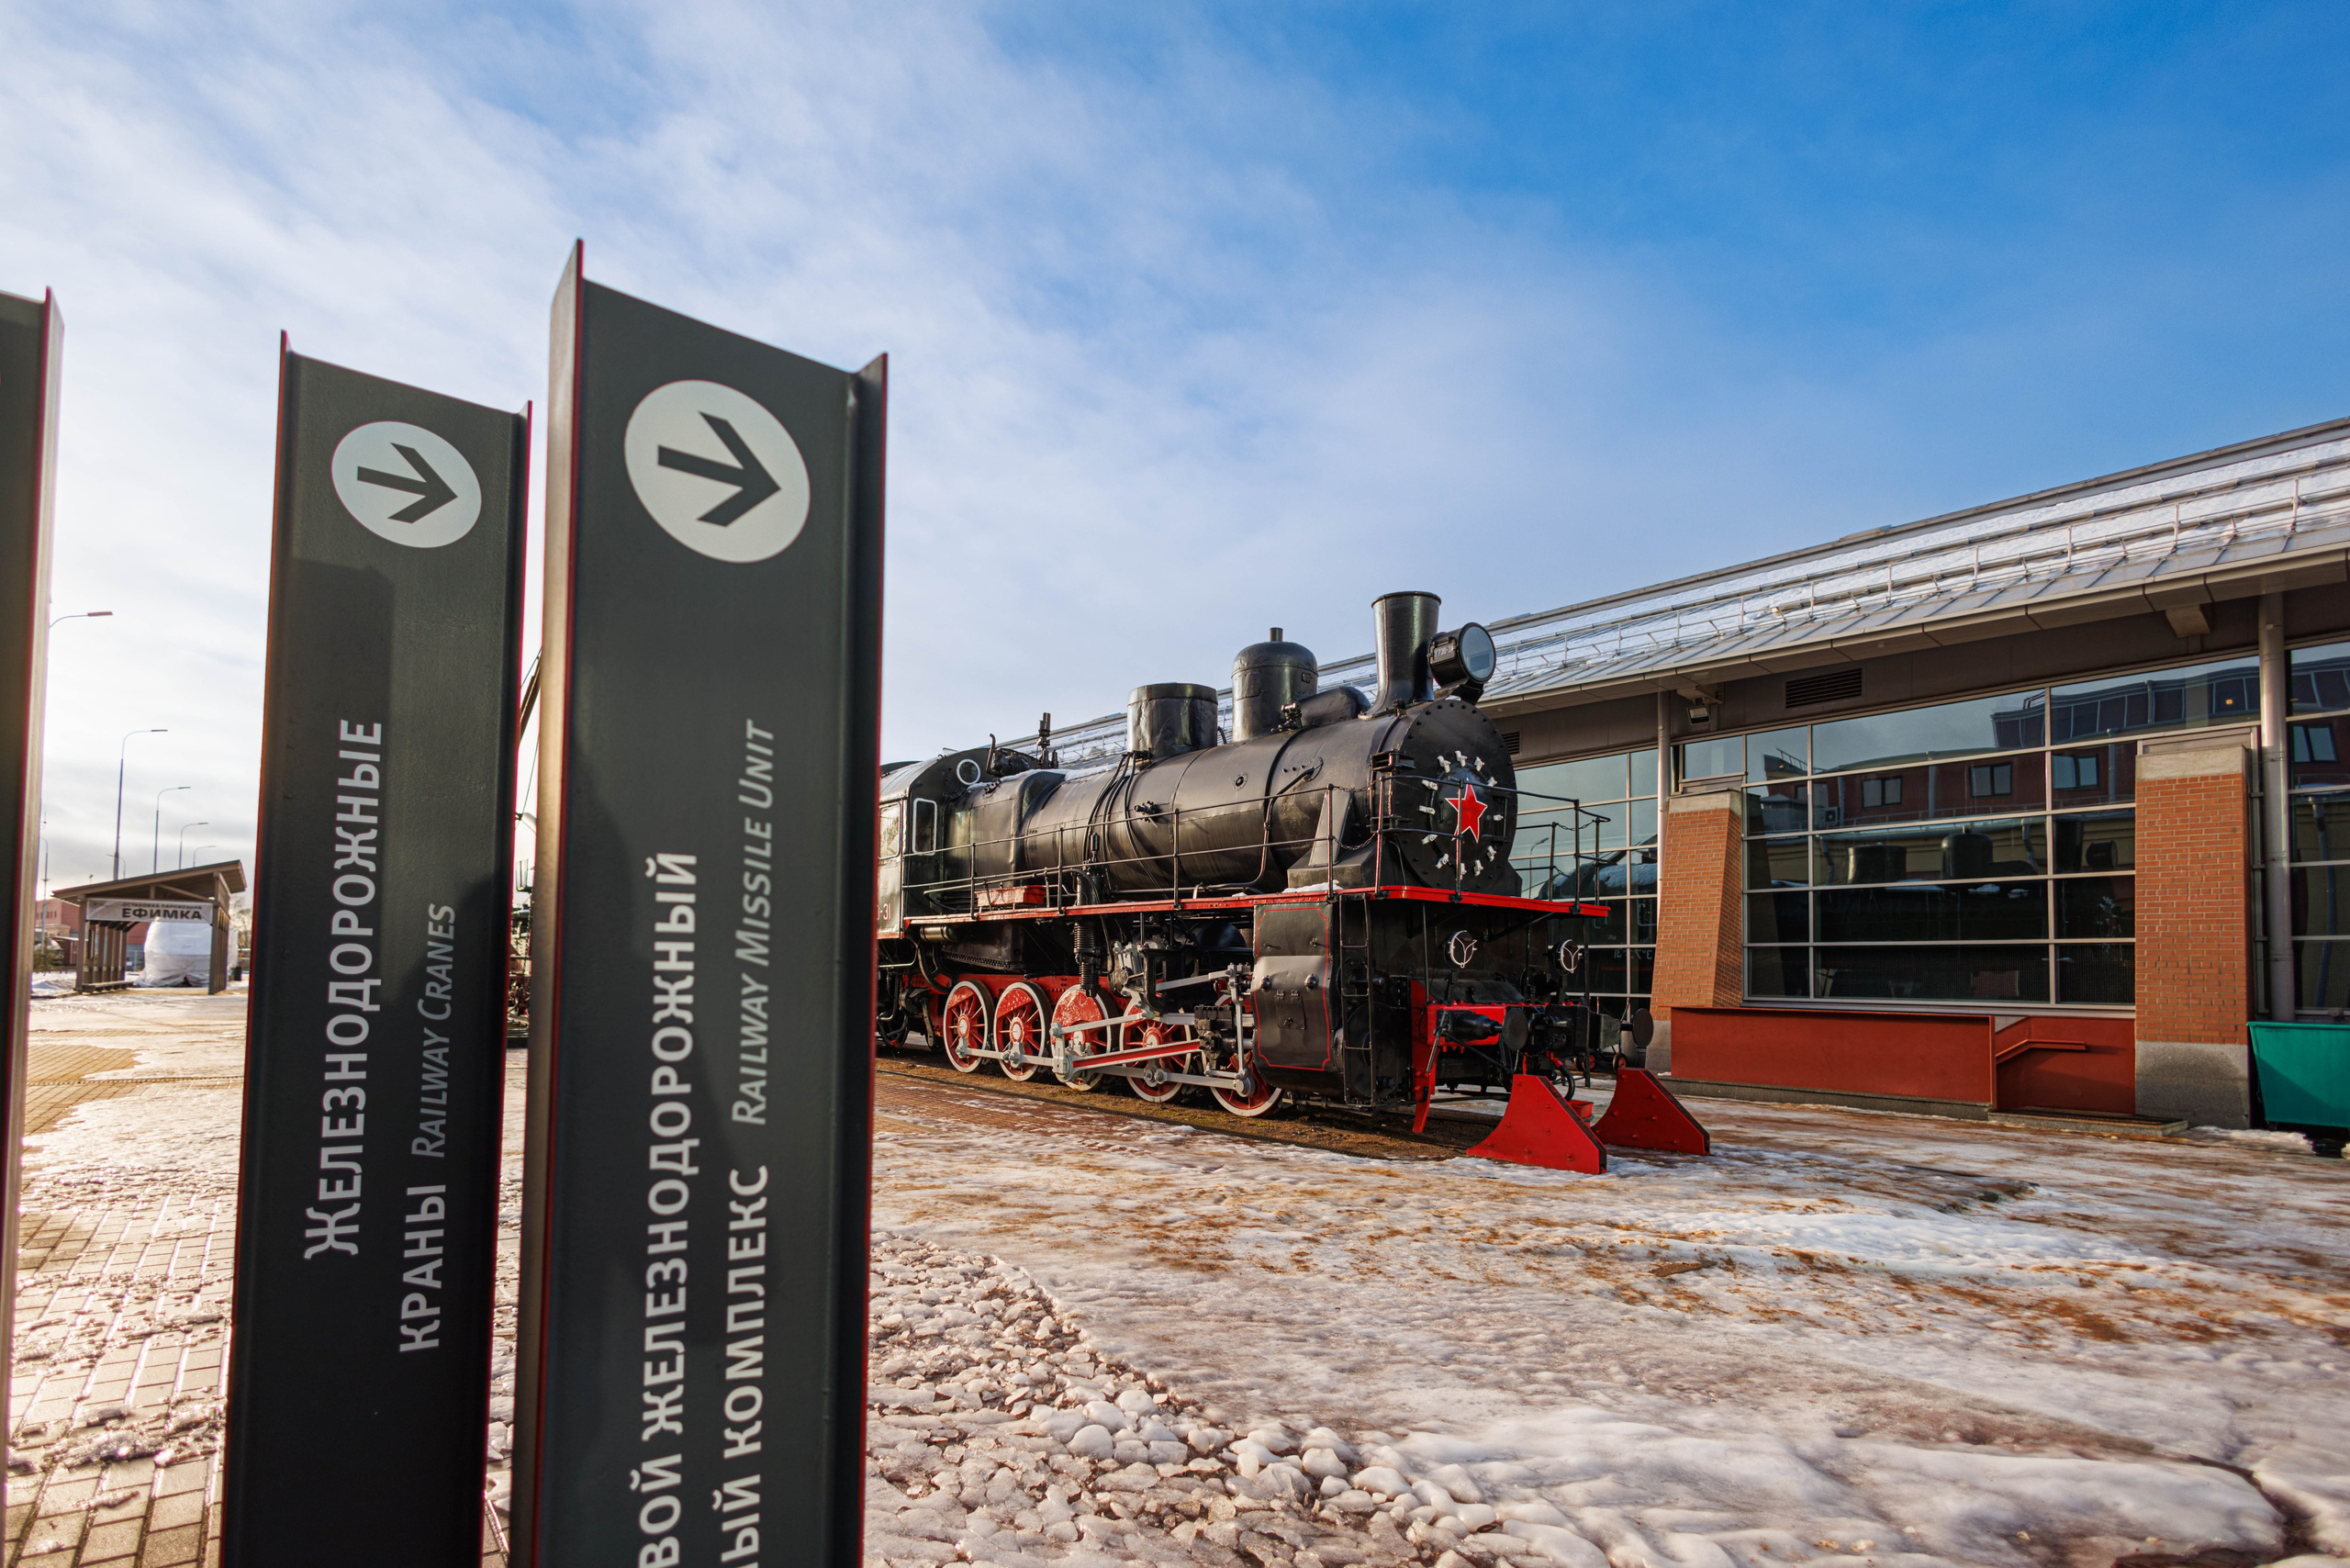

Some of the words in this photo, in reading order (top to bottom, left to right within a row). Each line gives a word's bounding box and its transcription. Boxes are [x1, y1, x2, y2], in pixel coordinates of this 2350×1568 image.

[122, 908, 202, 919] ЕФИМКА
[306, 721, 381, 1259] ЖЕЛЕЗНОДОРОЖНЫЕ
[643, 855, 699, 1440] ЖЕЛЕЗНОДОРОЖНЫЙ
[399, 1185, 445, 1351] КРАНЫ
[724, 1166, 767, 1458] КОМПЛЕКС
[712, 1474, 760, 1568] ЫЙ
